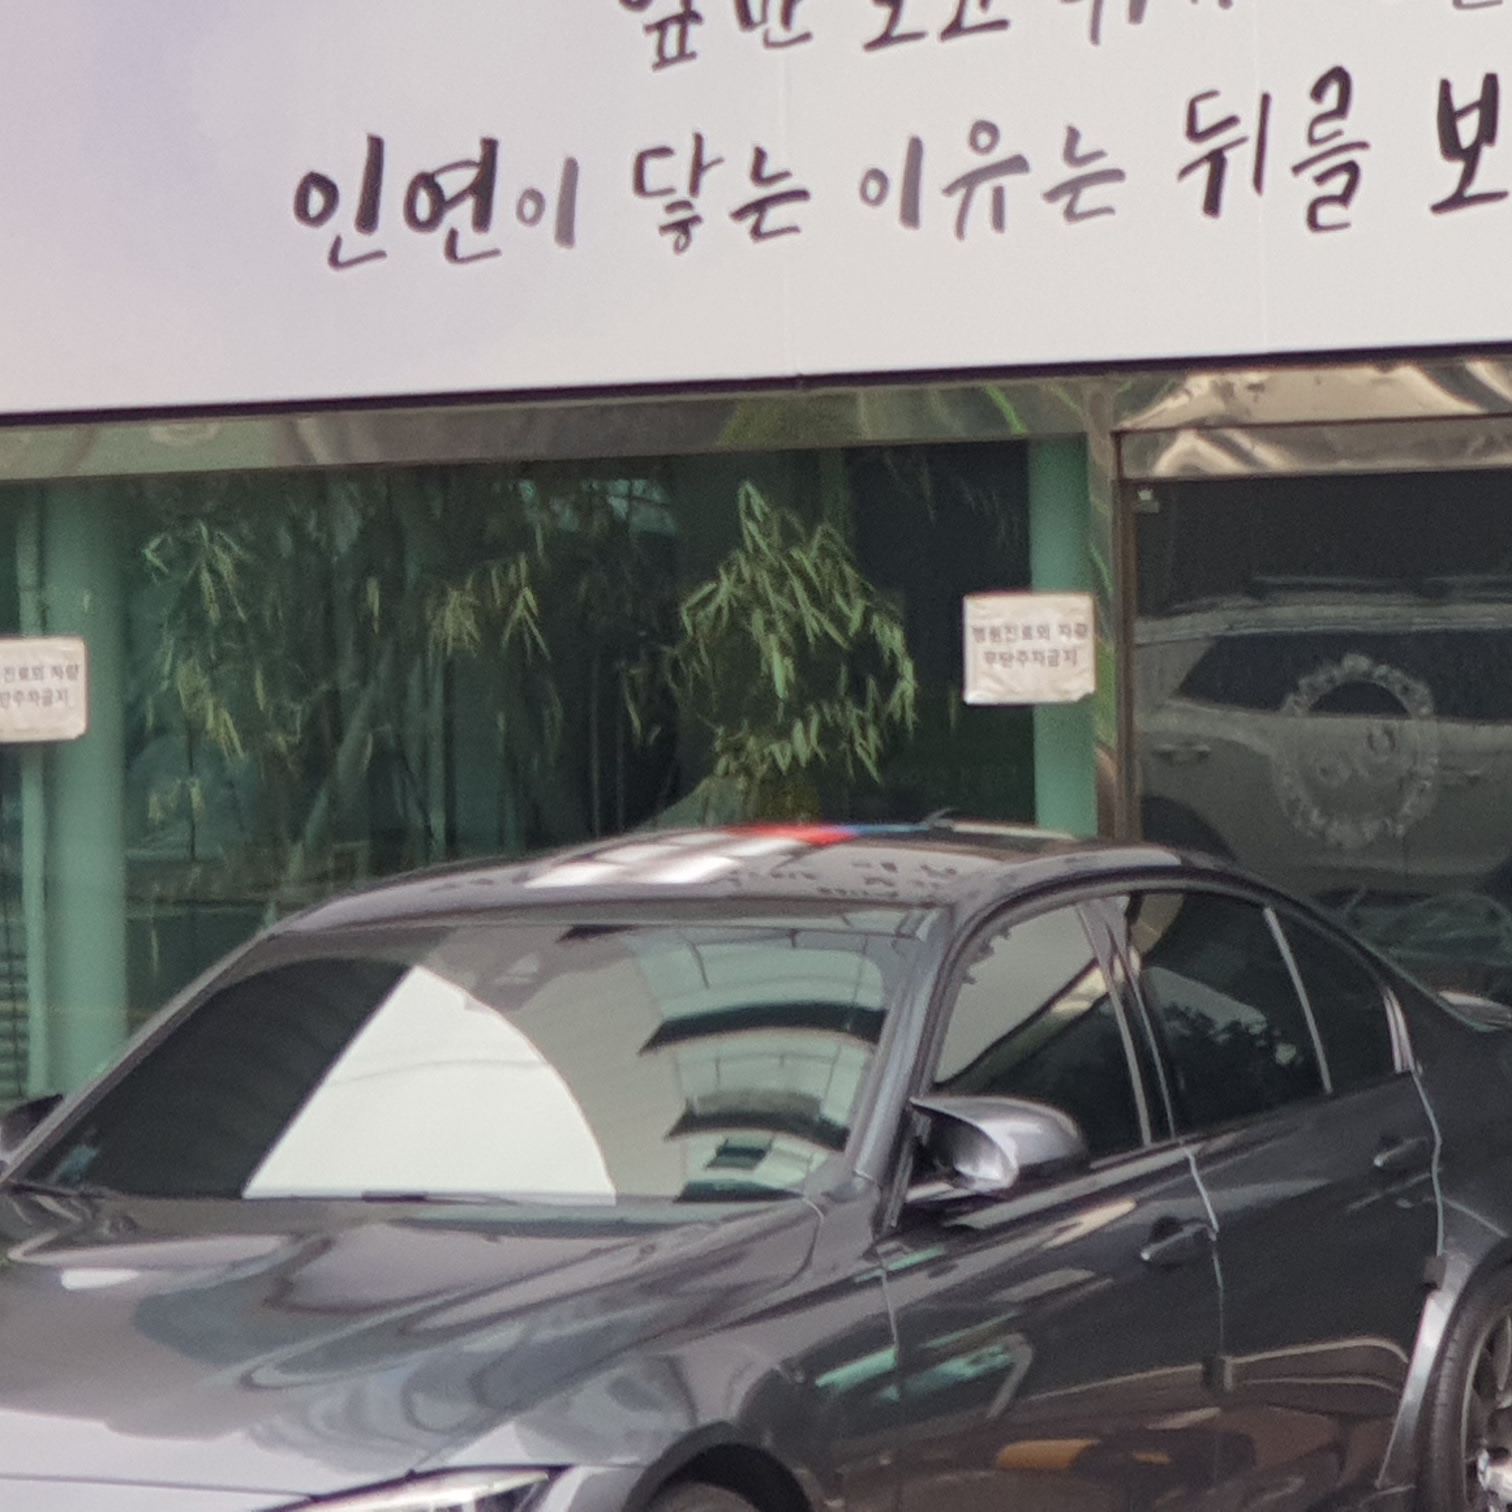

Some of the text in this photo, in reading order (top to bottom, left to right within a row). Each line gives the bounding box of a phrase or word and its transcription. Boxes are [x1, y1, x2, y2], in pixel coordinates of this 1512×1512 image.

[292, 134, 579, 270] 인연이
[632, 131, 811, 253] 닿는
[858, 118, 1127, 241] 이유는
[1177, 64, 1371, 233] 뒤를
